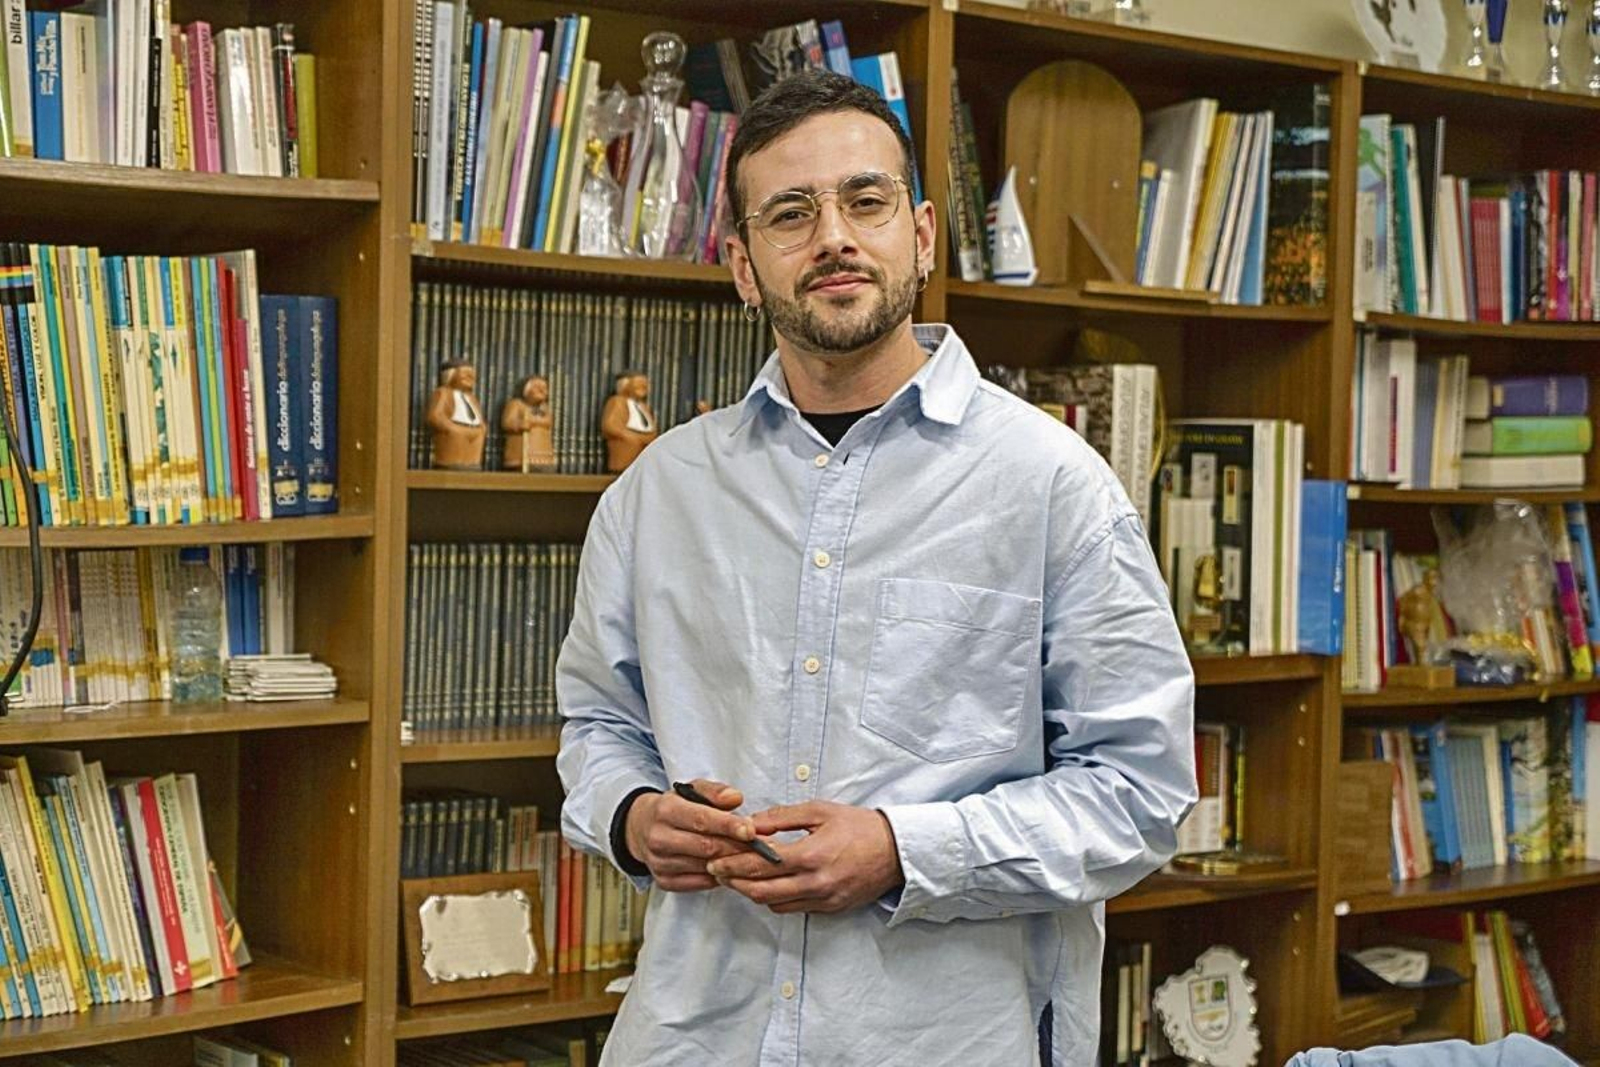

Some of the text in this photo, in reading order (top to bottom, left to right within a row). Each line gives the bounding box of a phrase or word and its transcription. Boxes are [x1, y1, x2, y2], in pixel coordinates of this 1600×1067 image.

[10, 6, 22, 44] billar
[277, 381, 290, 451] diccionario
[309, 381, 323, 450] diccionario
